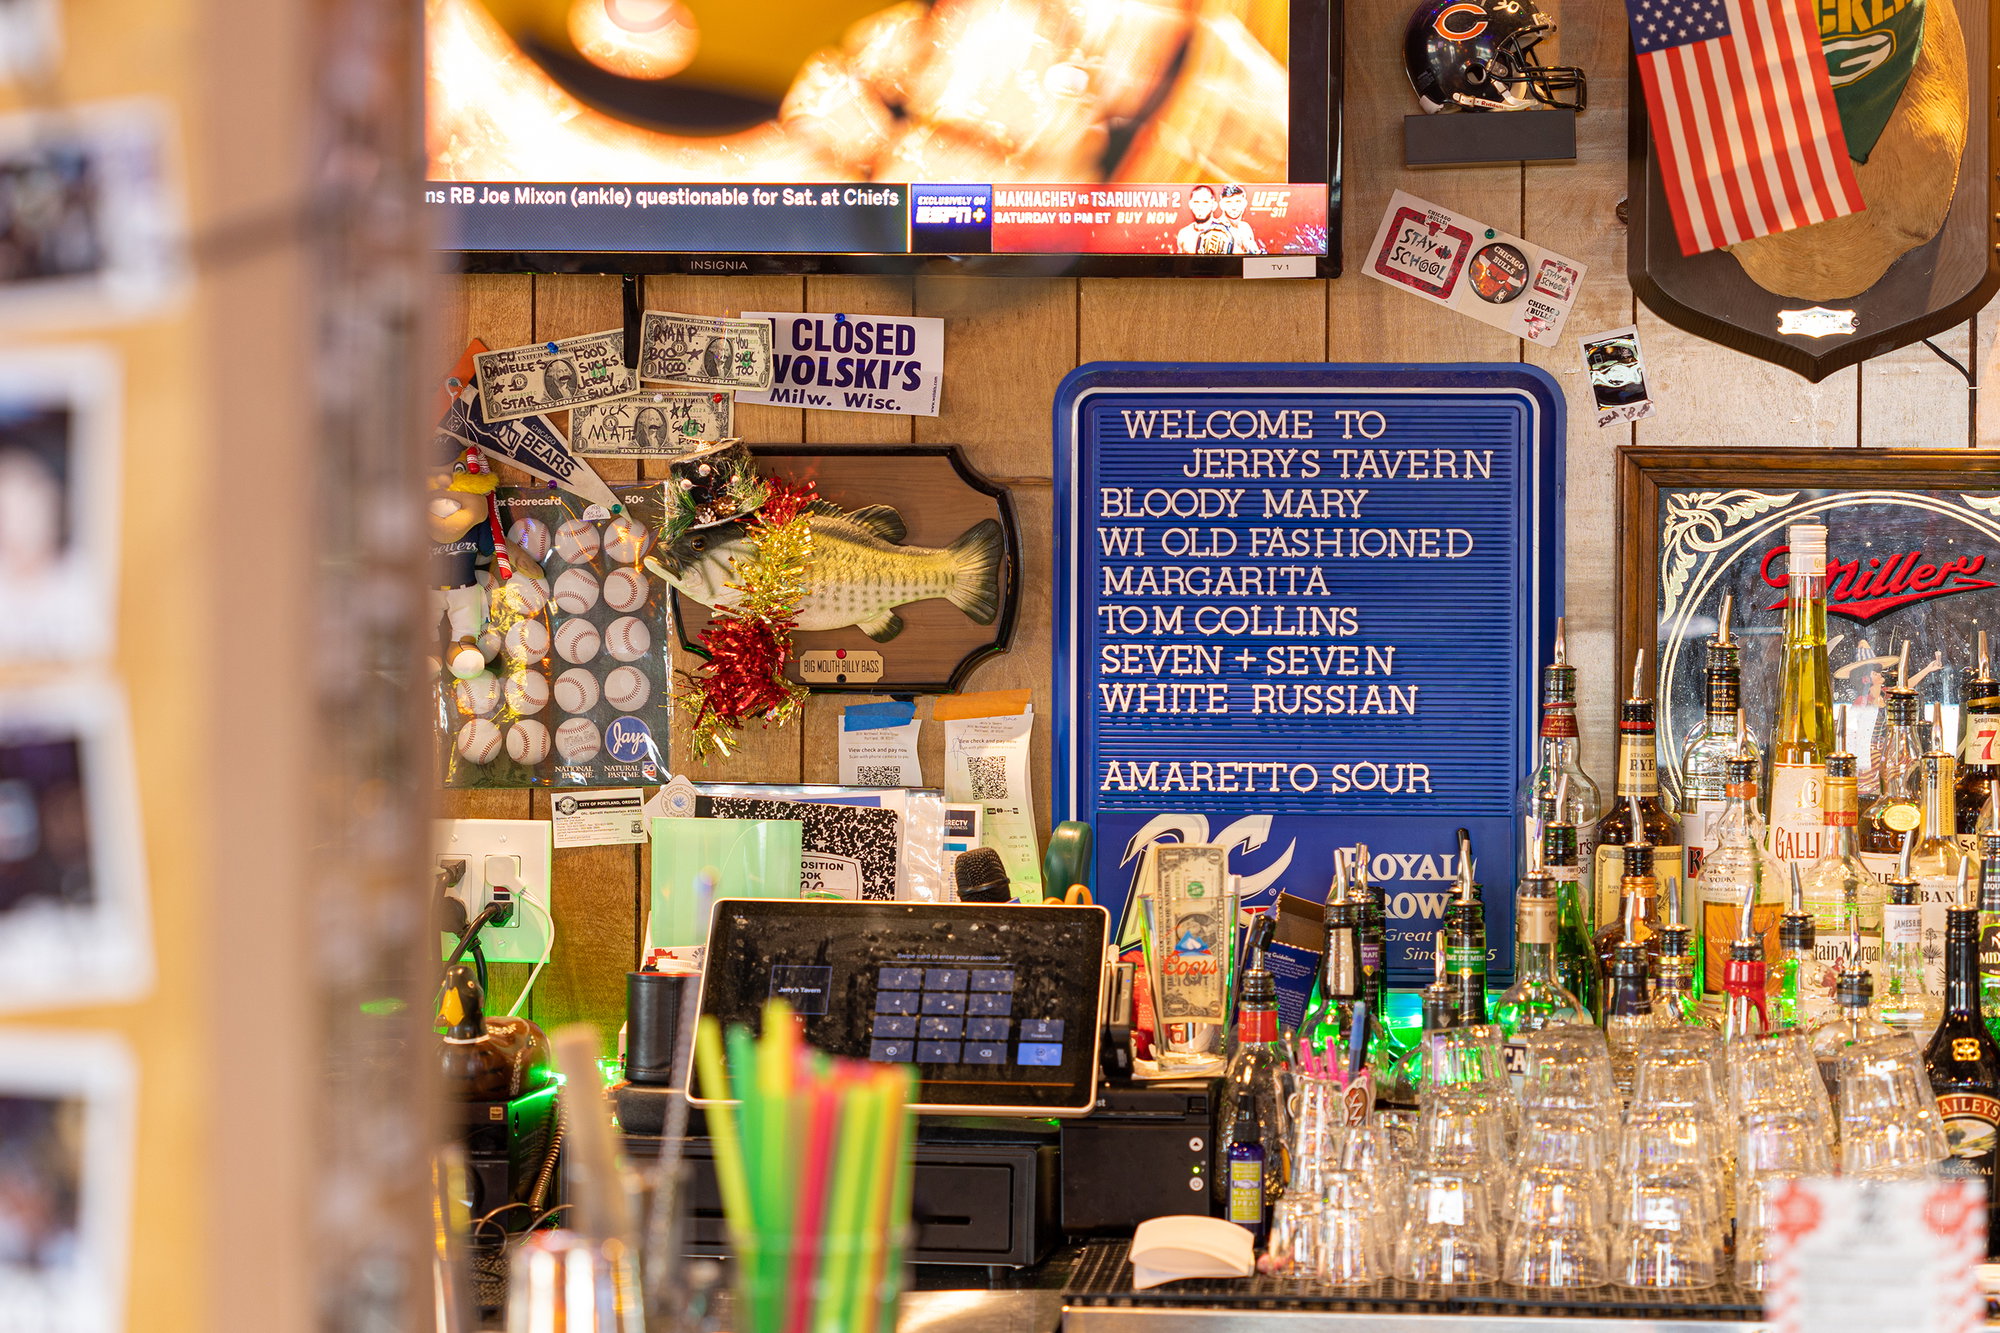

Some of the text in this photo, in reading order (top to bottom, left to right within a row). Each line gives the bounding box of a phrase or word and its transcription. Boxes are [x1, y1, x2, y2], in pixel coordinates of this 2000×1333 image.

[450, 187, 475, 204] RB
[479, 187, 510, 204] Joe
[515, 187, 566, 204] Mixon
[571, 187, 631, 208] (ankle)
[636, 188, 749, 208] questionable
[753, 188, 778, 205] for
[783, 188, 817, 206] Sat.
[821, 189, 839, 206] at
[844, 189, 899, 206] Chiefs
[918, 196, 987, 206] EXCLUSIVELY ON
[994, 191, 1181, 208] MAKHACHEV TSARUKYAN 2
[1251, 191, 1291, 207] UFC
[916, 206, 987, 223] ESPN+
[994, 212, 1178, 224] SATURDAY 10 PM ET BUY NOW
[1269, 207, 1287, 218] 311
[1399, 228, 1438, 253] STAY
[690, 260, 748, 270] INSIGNIA
[1391, 245, 1445, 281] SCHOOL
[1492, 255, 1516, 275] BULLS
[1494, 245, 1525, 270] CHICAGO
[1540, 277, 1567, 293] SCHOOL
[653, 325, 685, 343] RYAN
[791, 318, 917, 357] CLOSED
[573, 346, 607, 361] FOOD
[578, 352, 624, 374] SUCKS!
[649, 347, 678, 361] BOO
[735, 351, 757, 363] SUCK
[577, 373, 614, 390] JERRY
[588, 378, 632, 399] SUCKS!
[501, 395, 540, 410] STAR
[770, 388, 901, 411] Milw. Wisc.
[531, 423, 557, 446] CHICAGO
[1120, 409, 1387, 440] WELCOME TO
[520, 430, 576, 479] BEARS
[1183, 448, 1494, 480] JERRYS TAVERN
[507, 495, 645, 507] Scorecard 50¢
[1100, 487, 1369, 519] BLOODY MARY
[1097, 526, 1474, 559] WI OLD FASHIONED
[1101, 565, 1331, 597] MARGARITA
[1098, 604, 1359, 637] TOM COLLINS
[803, 659, 880, 673] BIG MOUTH BILLY BASS
[1101, 644, 1396, 676] SEVEN + SEVEN
[1099, 683, 1419, 716] WHITE RUSSIAN
[612, 721, 648, 755] Jays
[1976, 730, 1998, 760] 7
[554, 765, 640, 773] NATIONAL NATURAL
[607, 771, 641, 779] PASTIME.
[1630, 758, 1656, 772] RYE
[1101, 760, 1433, 795] AMARETTO SOUR
[1339, 846, 1477, 884] ROYAL
[1709, 875, 1737, 884] VODKA
[1894, 919, 1913, 930] JAMES
[1384, 928, 1433, 943] Great
[956, 954, 970, 962] your
[1842, 941, 1881, 965] Mrgan
[1163, 954, 1219, 976] Coors
[778, 986, 800, 994] Jerry's
[1940, 1097, 2000, 1118] AILEYS
